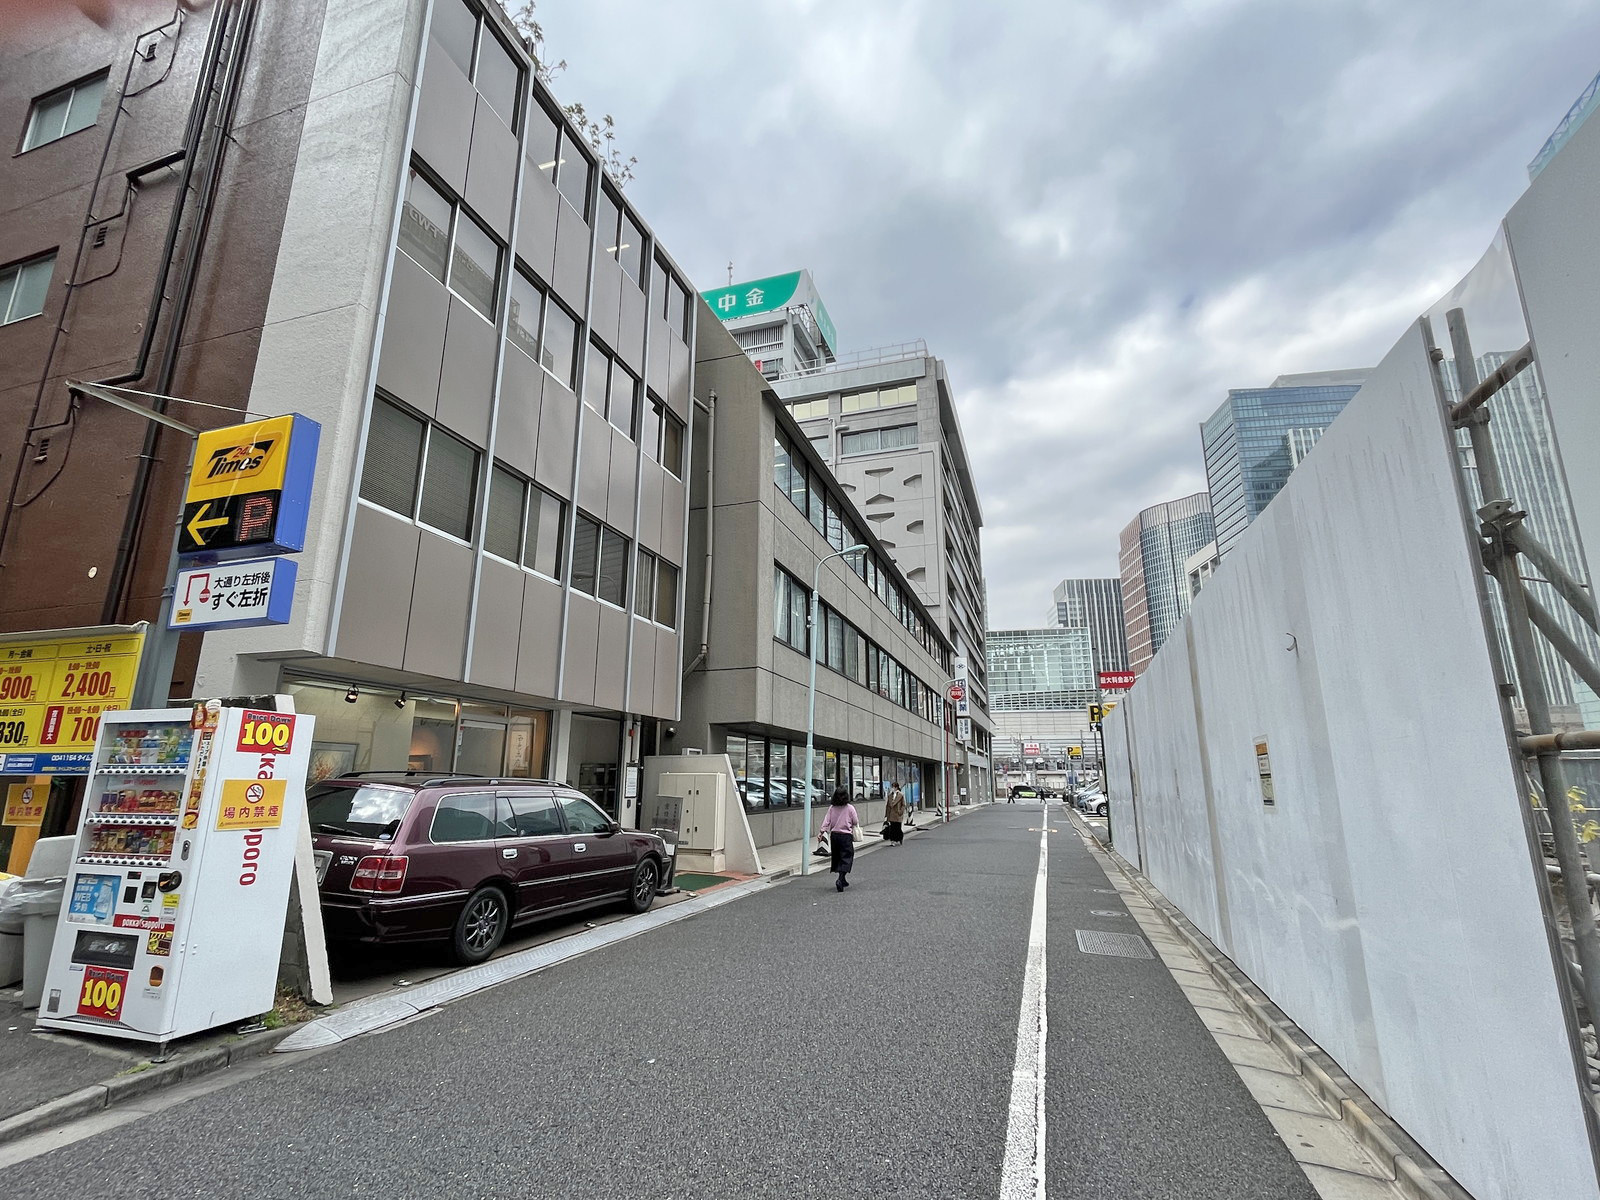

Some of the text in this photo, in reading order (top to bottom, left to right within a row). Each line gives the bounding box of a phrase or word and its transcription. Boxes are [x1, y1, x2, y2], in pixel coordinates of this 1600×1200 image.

[705, 287, 764, 312] 中金
[207, 455, 264, 479] Times
[240, 496, 273, 542] P
[213, 571, 270, 590] 大通り左折後
[212, 586, 268, 610] すぐ左折
[241, 721, 290, 747] 100
[223, 806, 279, 818] 場内禁煙
[81, 979, 121, 1010] 100
